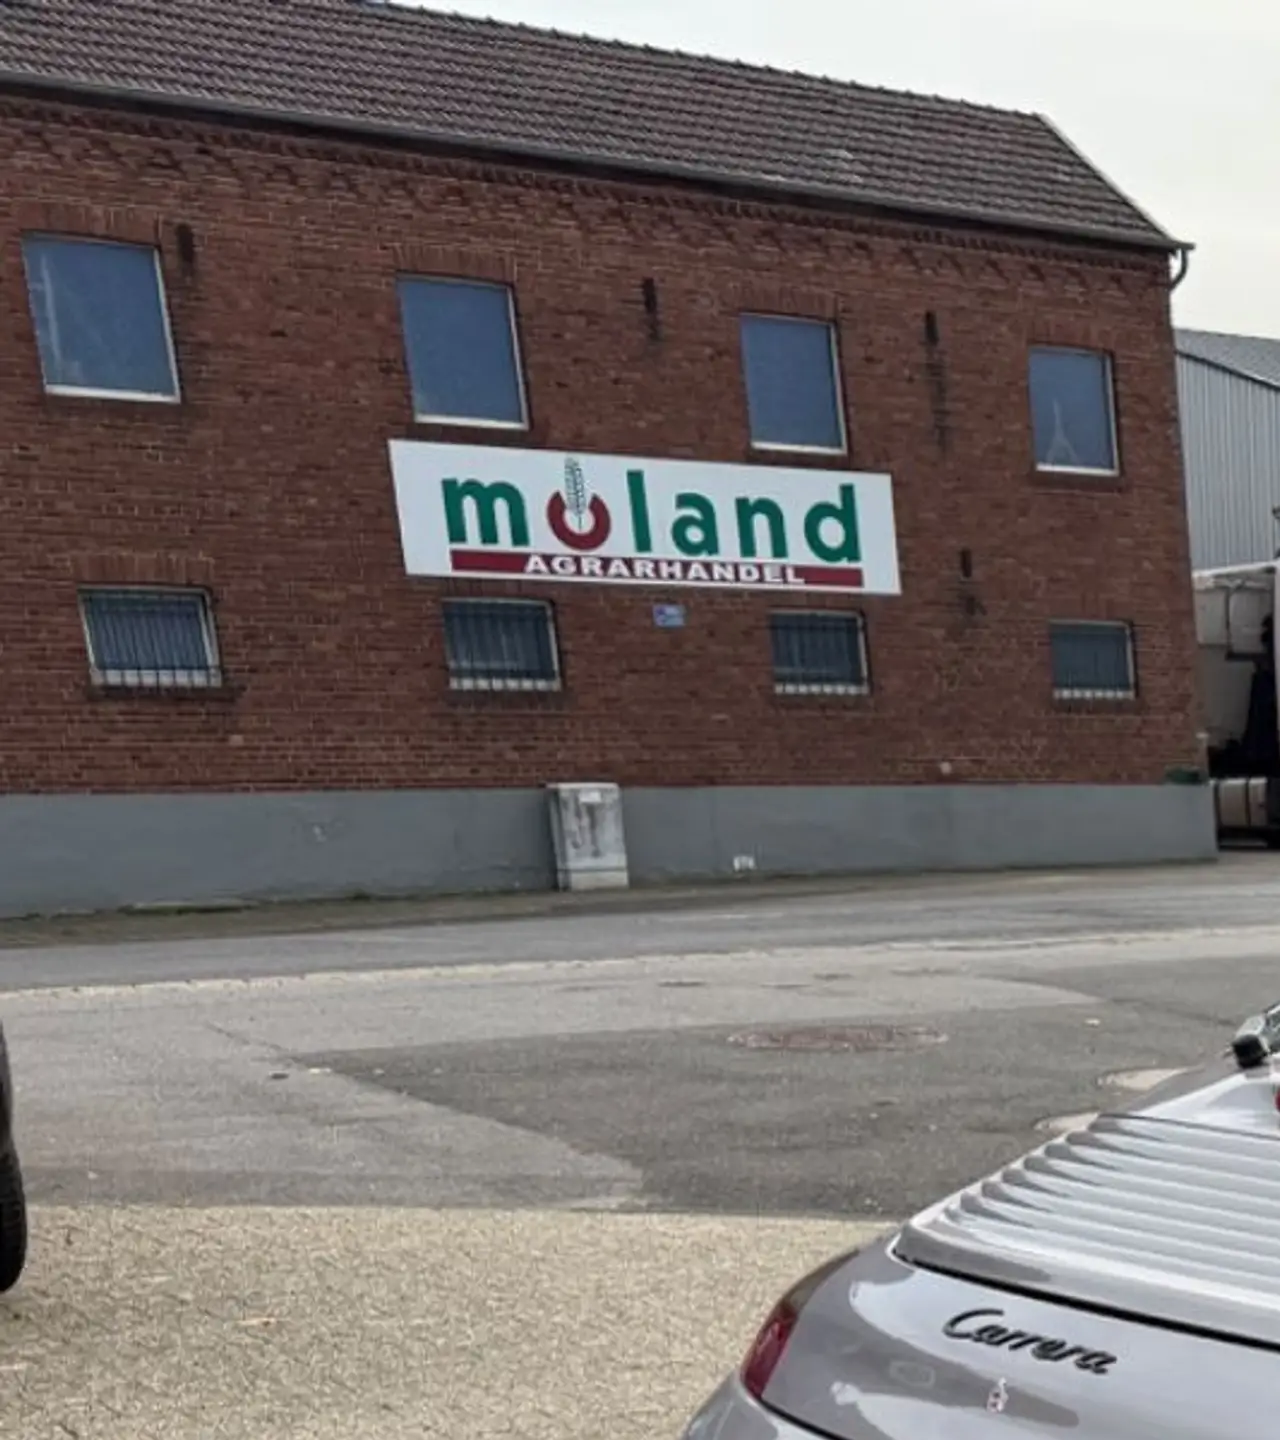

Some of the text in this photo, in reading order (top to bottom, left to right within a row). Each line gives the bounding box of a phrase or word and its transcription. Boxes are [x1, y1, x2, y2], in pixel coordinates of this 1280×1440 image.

[441, 466, 862, 563] moland
[524, 554, 806, 585] AGRARHANDEL
[942, 1308, 1118, 1375] Carrera
